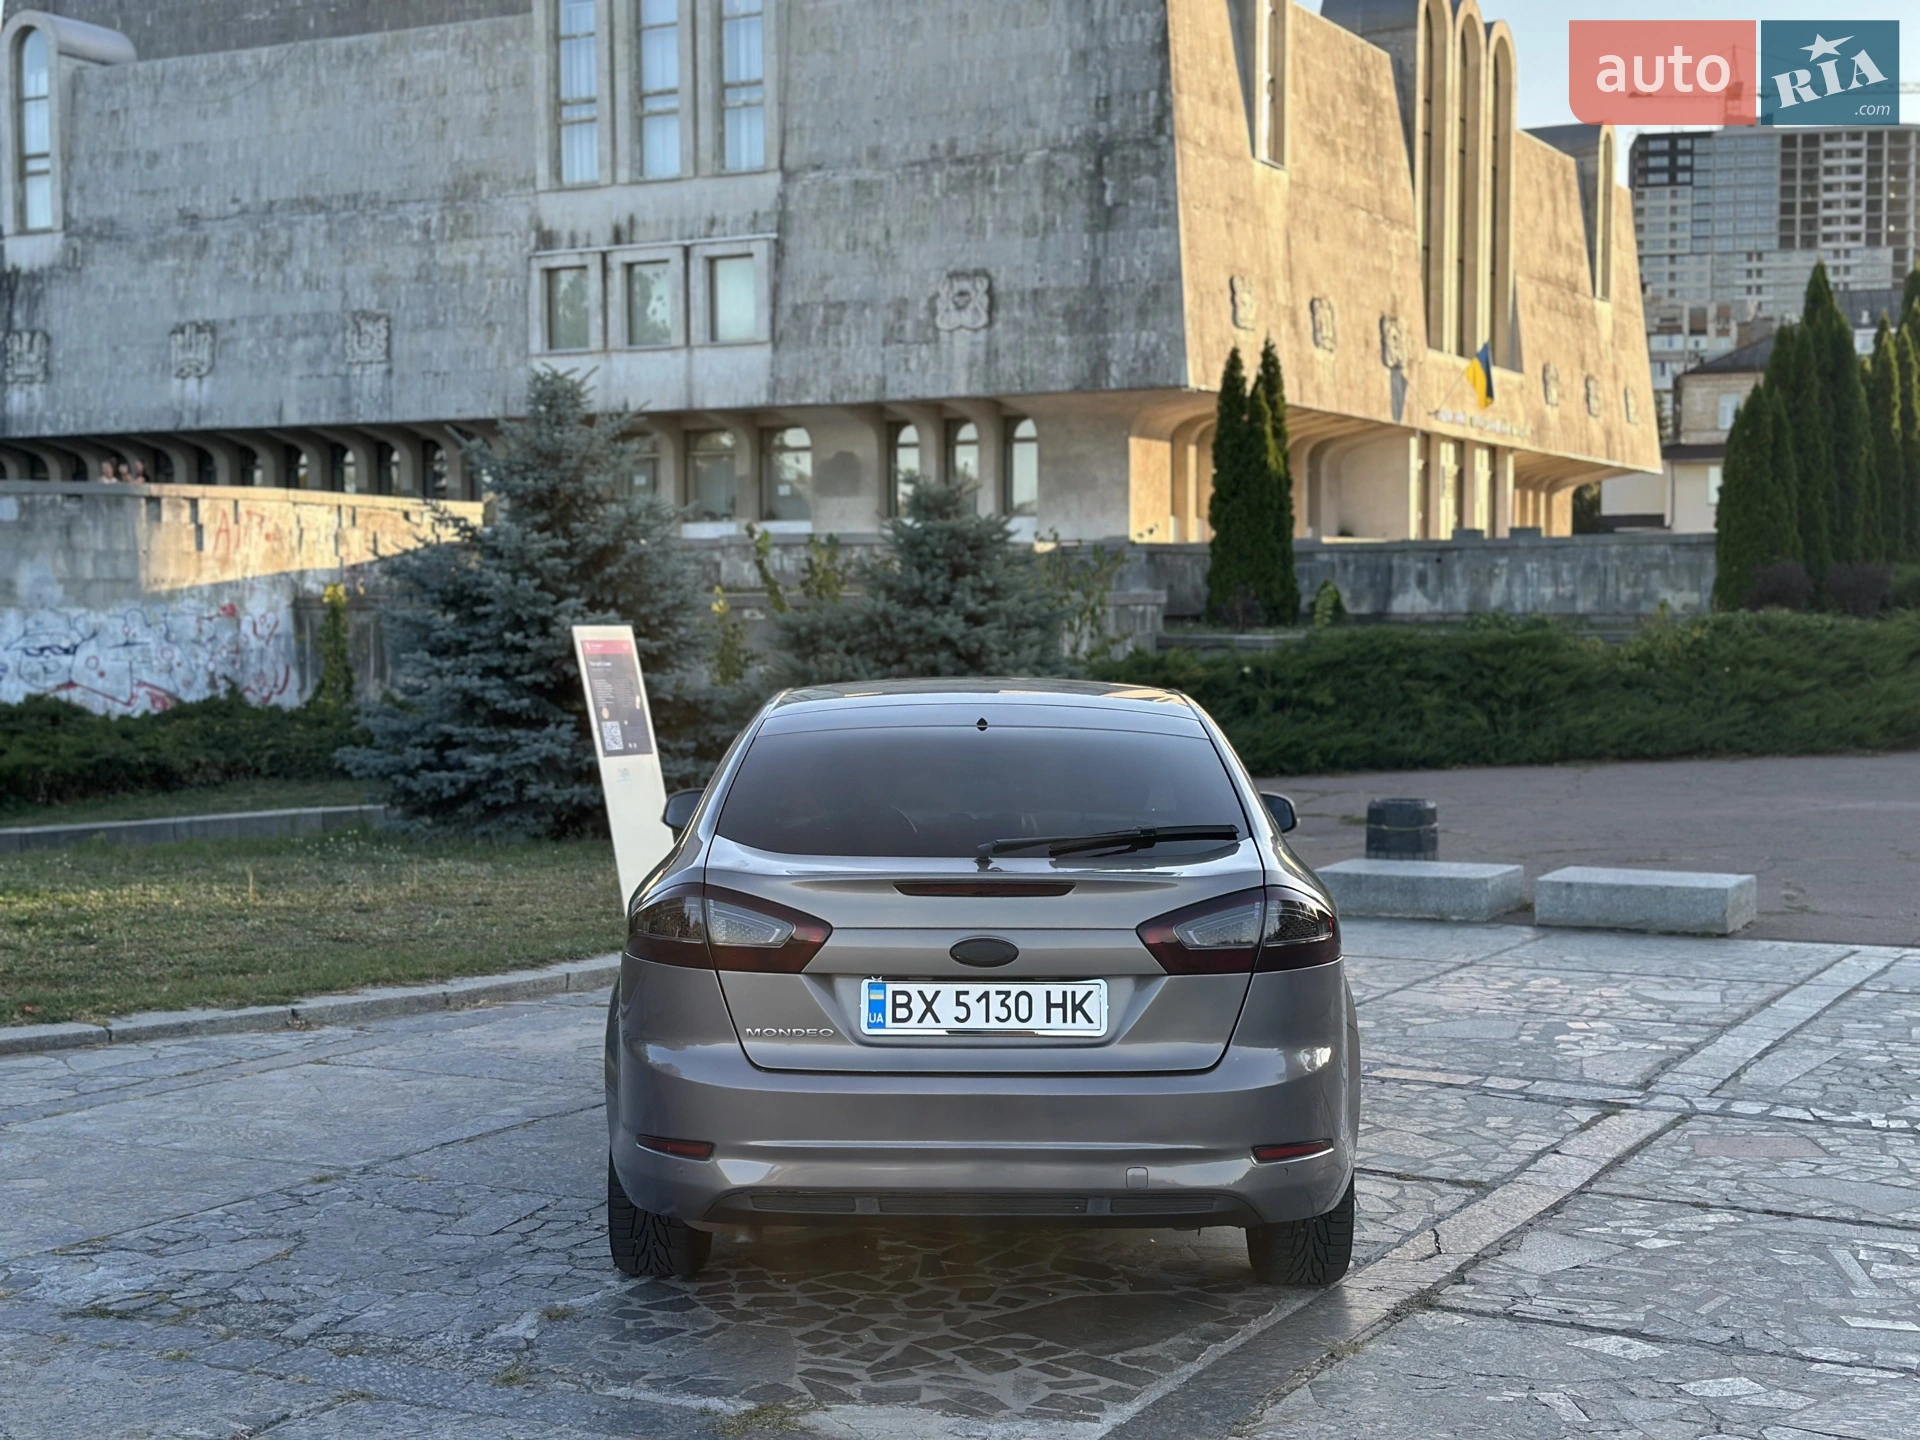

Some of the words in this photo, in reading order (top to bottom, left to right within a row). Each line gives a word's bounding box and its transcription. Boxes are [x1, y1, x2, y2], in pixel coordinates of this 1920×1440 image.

[891, 990, 941, 1024] BX
[953, 990, 1032, 1024] 5130
[1045, 990, 1095, 1024] HK
[868, 1012, 884, 1024] UA
[745, 1028, 835, 1038] MONDEO
